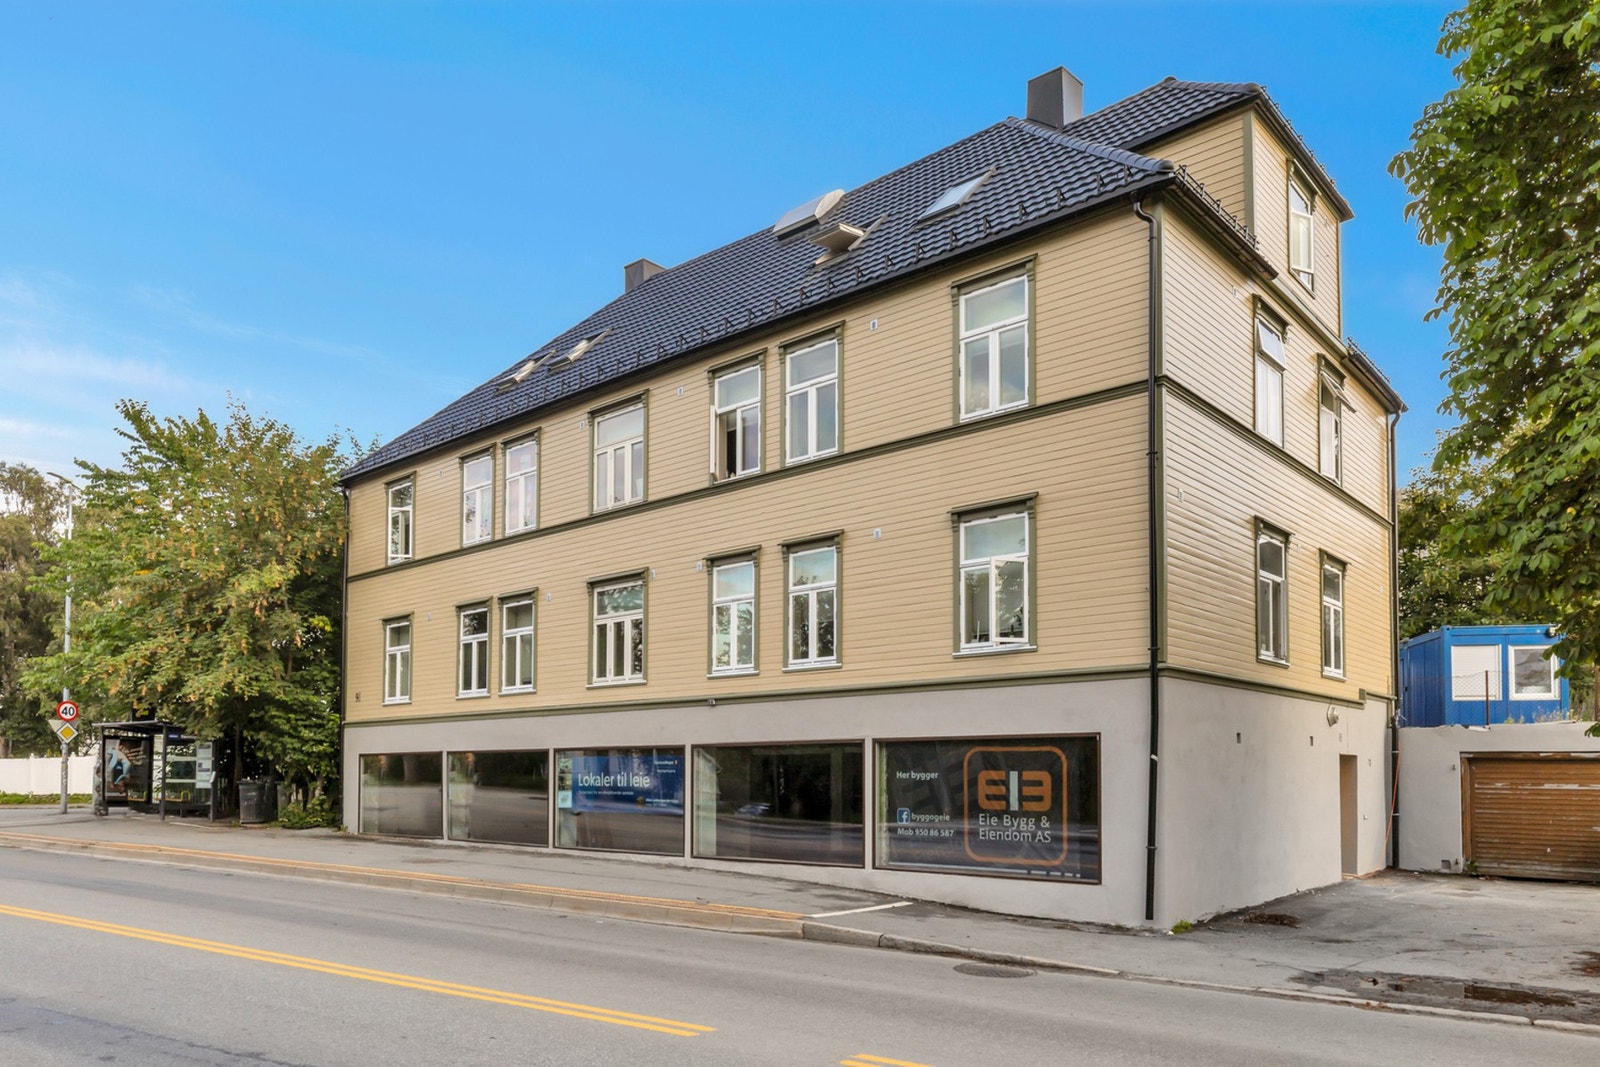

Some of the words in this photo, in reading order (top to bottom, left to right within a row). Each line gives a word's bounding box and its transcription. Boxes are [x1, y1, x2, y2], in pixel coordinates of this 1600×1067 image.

[61, 706, 75, 717] 40
[578, 772, 614, 787] Lokaler
[617, 772, 627, 787] til
[629, 772, 650, 788] leie
[896, 771, 910, 779] Her
[911, 771, 939, 781] bygger
[911, 812, 951, 823] byggogeie
[979, 813, 998, 826] Eie
[1003, 814, 1036, 831] Bygg
[1040, 815, 1050, 828] &
[897, 828, 914, 836] Mob
[940, 829, 955, 837] 587
[979, 828, 1032, 842] Eiendom
[1034, 830, 1052, 843] AS
